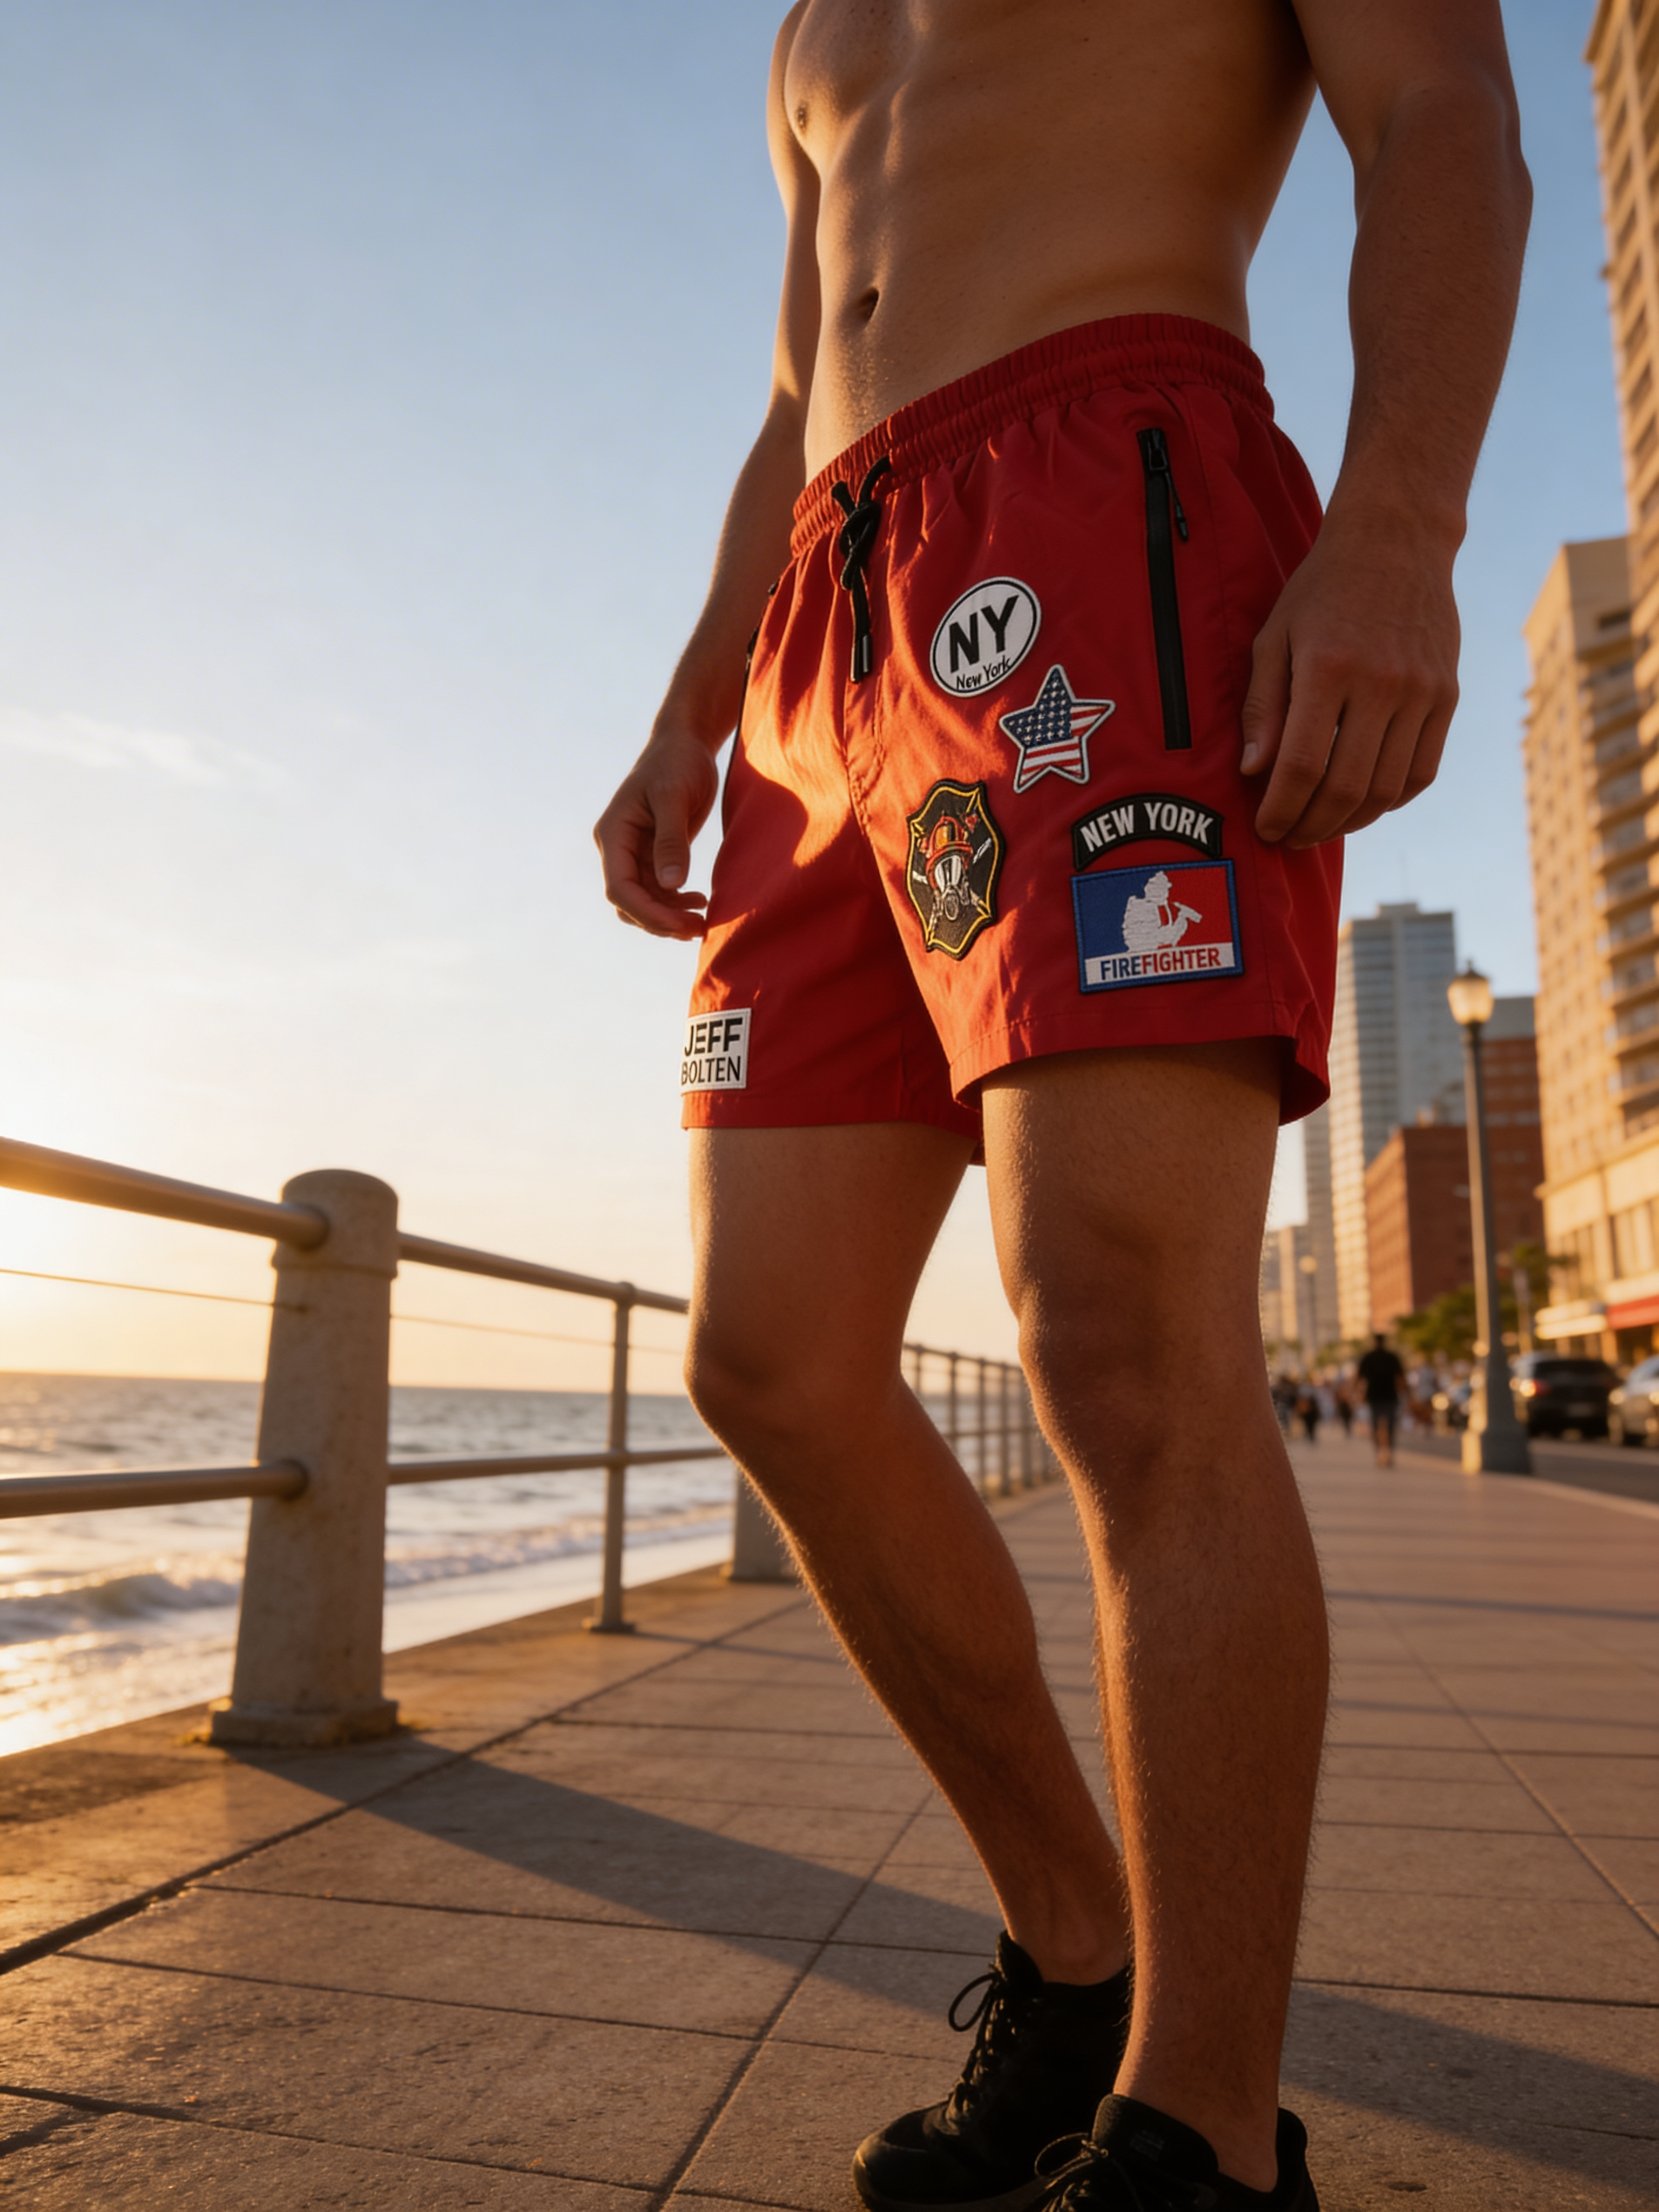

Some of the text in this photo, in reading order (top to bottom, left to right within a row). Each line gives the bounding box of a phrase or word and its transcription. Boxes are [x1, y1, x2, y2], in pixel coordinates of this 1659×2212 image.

[949, 595, 1019, 673] NY
[956, 655, 1011, 689] New York
[1081, 802, 1213, 852] NEW YORK
[1101, 947, 1220, 980] FIREFIGHTER
[684, 1017, 743, 1056] JEFF
[681, 1055, 740, 1086] BOLTEN
